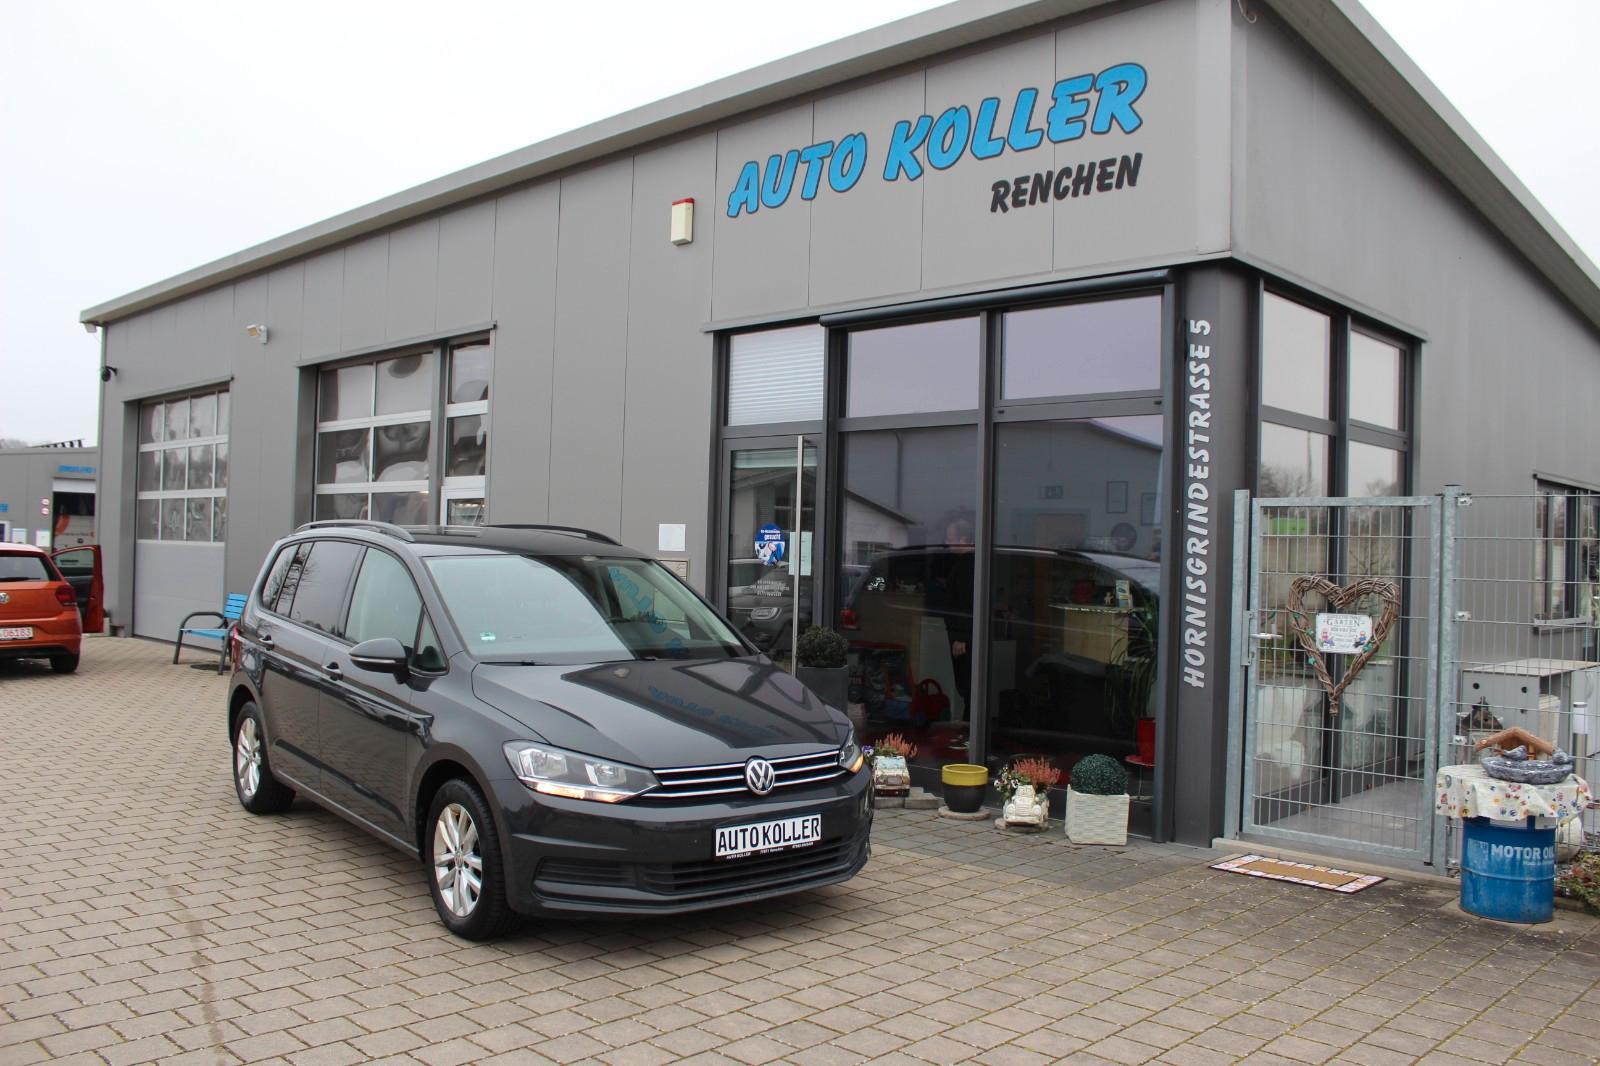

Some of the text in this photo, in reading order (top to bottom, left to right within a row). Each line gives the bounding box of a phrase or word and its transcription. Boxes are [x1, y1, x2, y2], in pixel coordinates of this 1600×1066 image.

[727, 62, 1148, 218] AUTO KOLLER
[990, 152, 1143, 213] RENCHEN
[1183, 319, 1211, 689] HORNISGRINDESTRASSE 5
[718, 817, 820, 852] AUTO KOLLER
[1491, 843, 1541, 860] MOTOR
